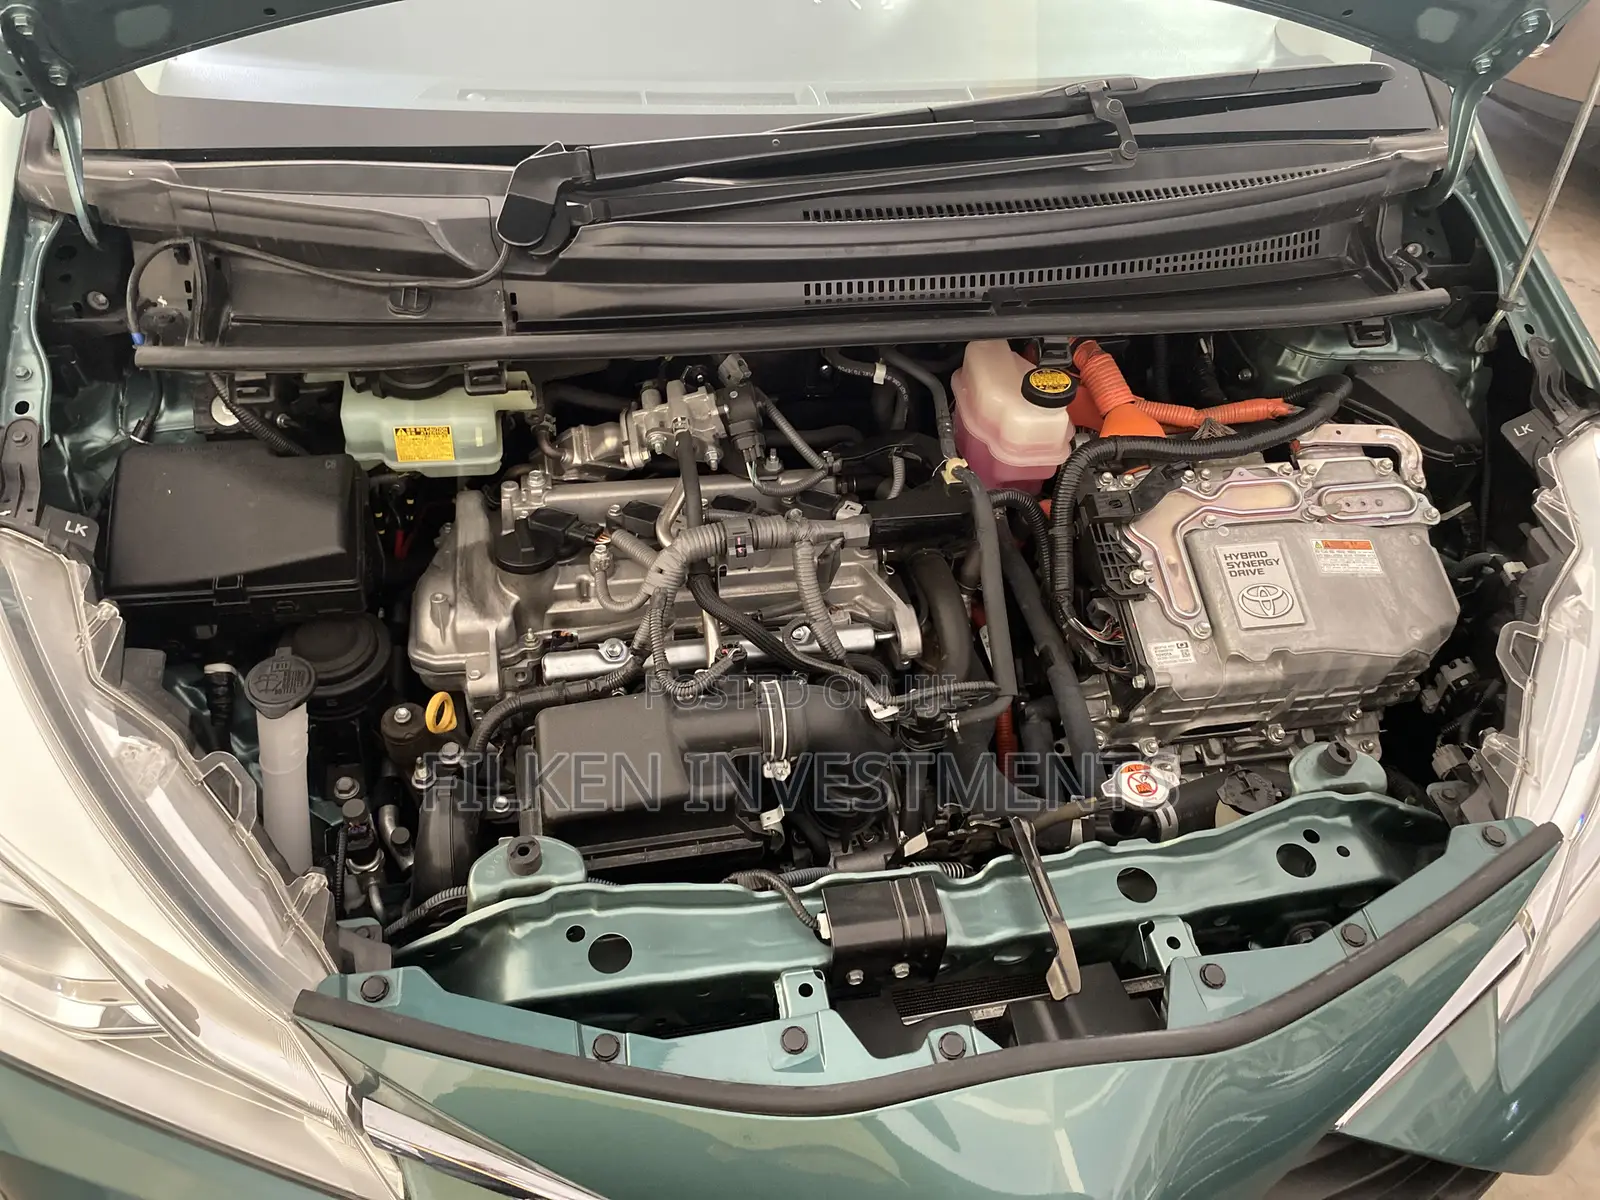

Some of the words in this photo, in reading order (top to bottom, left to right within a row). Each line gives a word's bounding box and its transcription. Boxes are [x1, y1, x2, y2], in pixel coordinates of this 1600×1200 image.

[1513, 423, 1533, 437] LK
[64, 520, 89, 537] LK
[1223, 550, 1269, 561] HYBRID
[1226, 558, 1280, 570] SYNERGY
[1228, 567, 1265, 578] DRIVE
